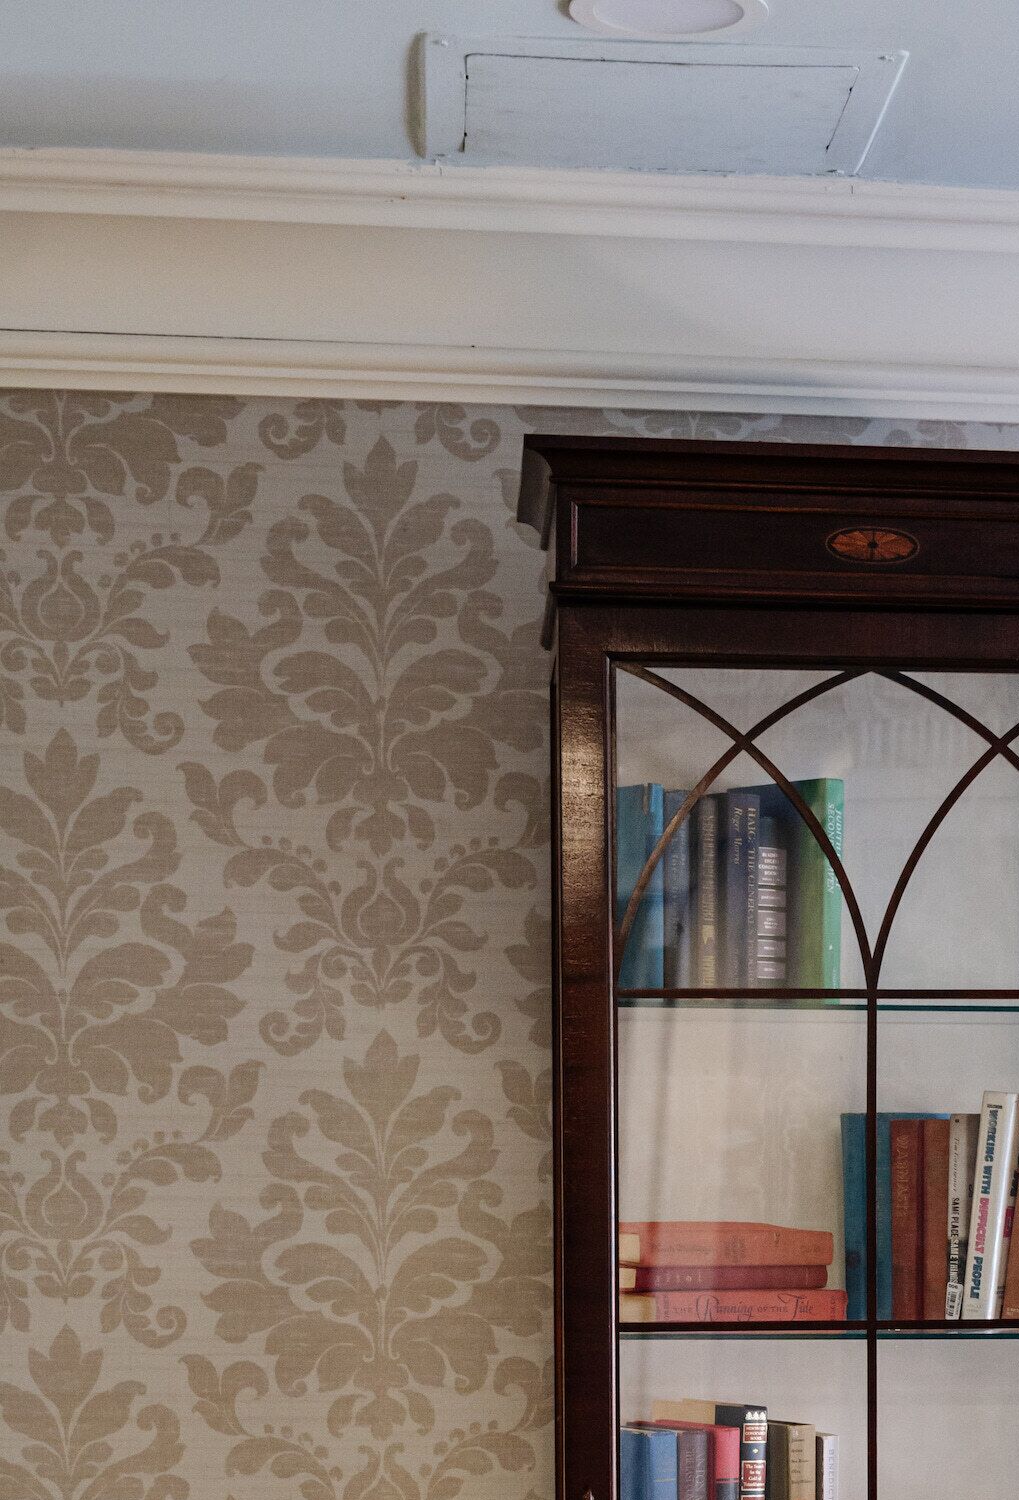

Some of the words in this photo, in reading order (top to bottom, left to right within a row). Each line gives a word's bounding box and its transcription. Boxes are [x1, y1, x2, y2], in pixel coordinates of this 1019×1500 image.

[732, 807, 742, 832] Roger
[733, 838, 742, 864] Morris
[748, 848, 756, 871] THE
[984, 1108, 999, 1162] WORKING
[980, 1165, 993, 1195] WITH
[951, 1198, 960, 1216] SAME
[975, 1197, 990, 1254] DIFFICULT
[950, 1238, 960, 1260] SAME
[970, 1255, 984, 1300] PEOPLE
[696, 1294, 754, 1322] Running
[777, 1293, 814, 1321] Tide
